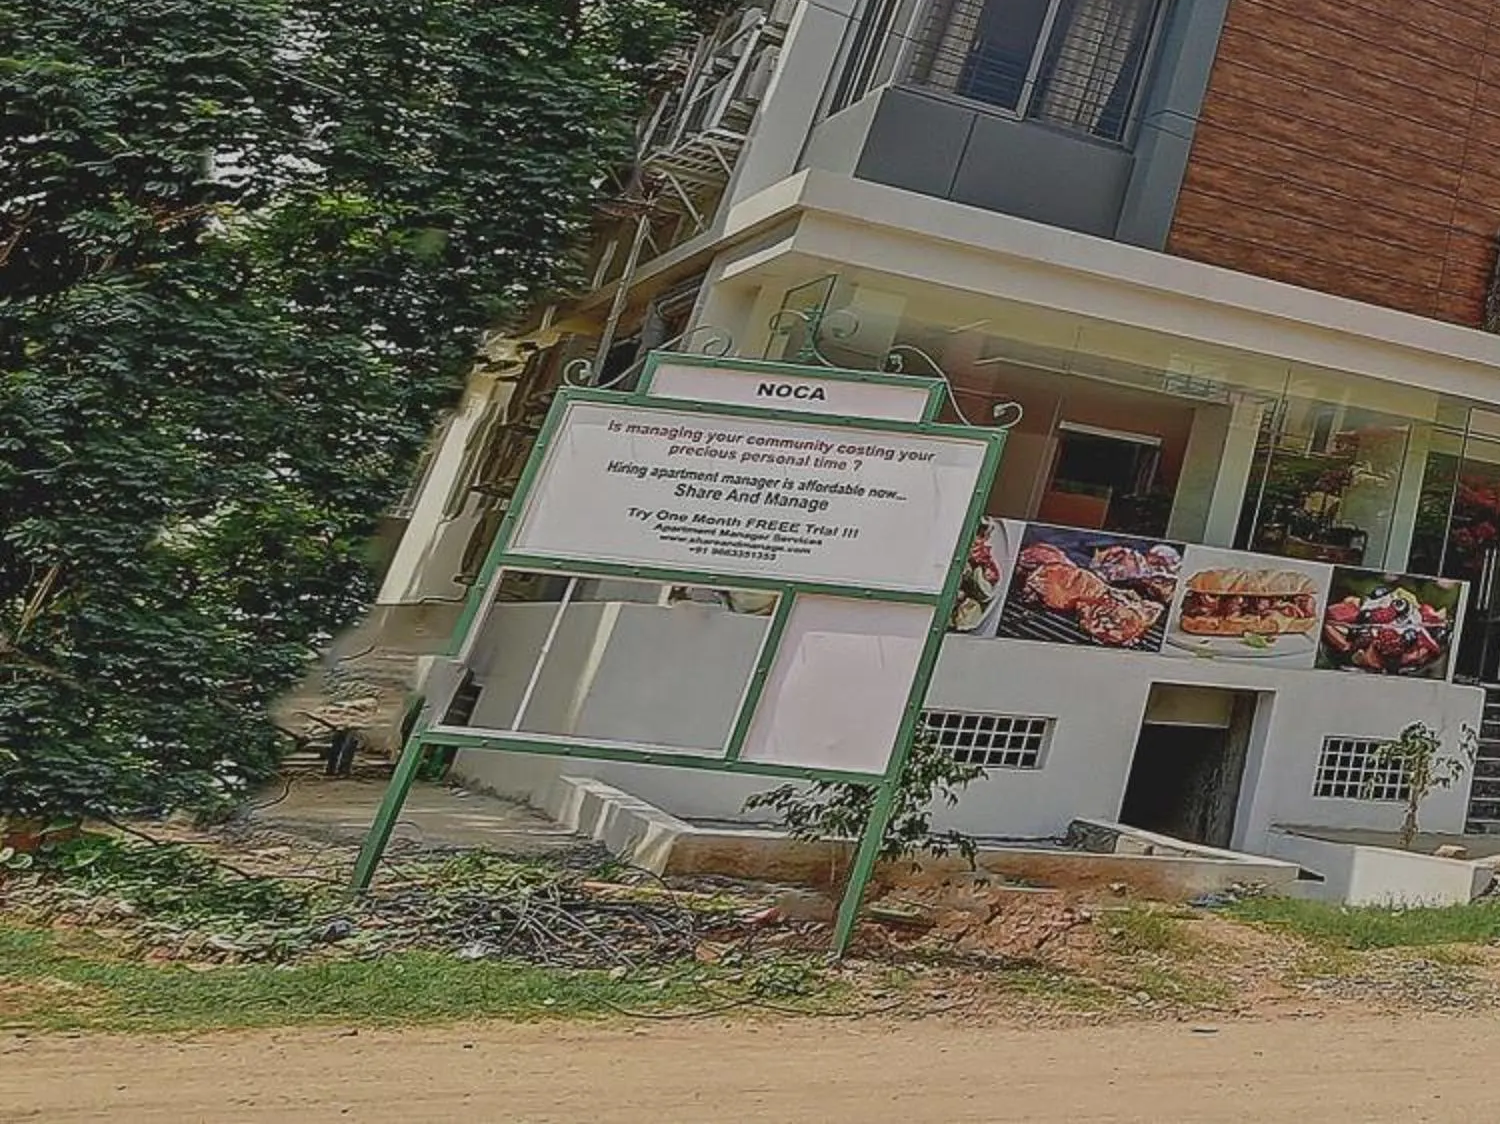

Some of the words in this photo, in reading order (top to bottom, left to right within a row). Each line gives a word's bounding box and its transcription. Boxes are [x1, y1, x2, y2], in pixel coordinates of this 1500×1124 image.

[757, 382, 827, 402] NOCA
[607, 419, 623, 432] Is
[625, 423, 704, 442] managing
[705, 431, 744, 444] your
[746, 435, 835, 454] community
[836, 444, 895, 461] costing
[898, 451, 936, 463] your
[668, 444, 737, 459] precious
[740, 451, 811, 467] personal
[813, 456, 848, 470] time
[853, 459, 863, 472] ?
[607, 460, 649, 479] Hiring
[650, 466, 720, 483] apartment
[721, 474, 781, 490] manager
[782, 477, 794, 490] is
[797, 479, 865, 497] affordable
[673, 483, 723, 501] Share
[725, 488, 762, 505] And
[763, 492, 829, 513] Manage
[627, 507, 653, 521] Try
[655, 509, 689, 522] One
[691, 513, 741, 528] Month
[745, 519, 801, 534] FREEE
[805, 524, 838, 537] Trial
[653, 523, 717, 536] Apartment
[718, 529, 770, 542] Manager
[773, 534, 823, 546] Services
